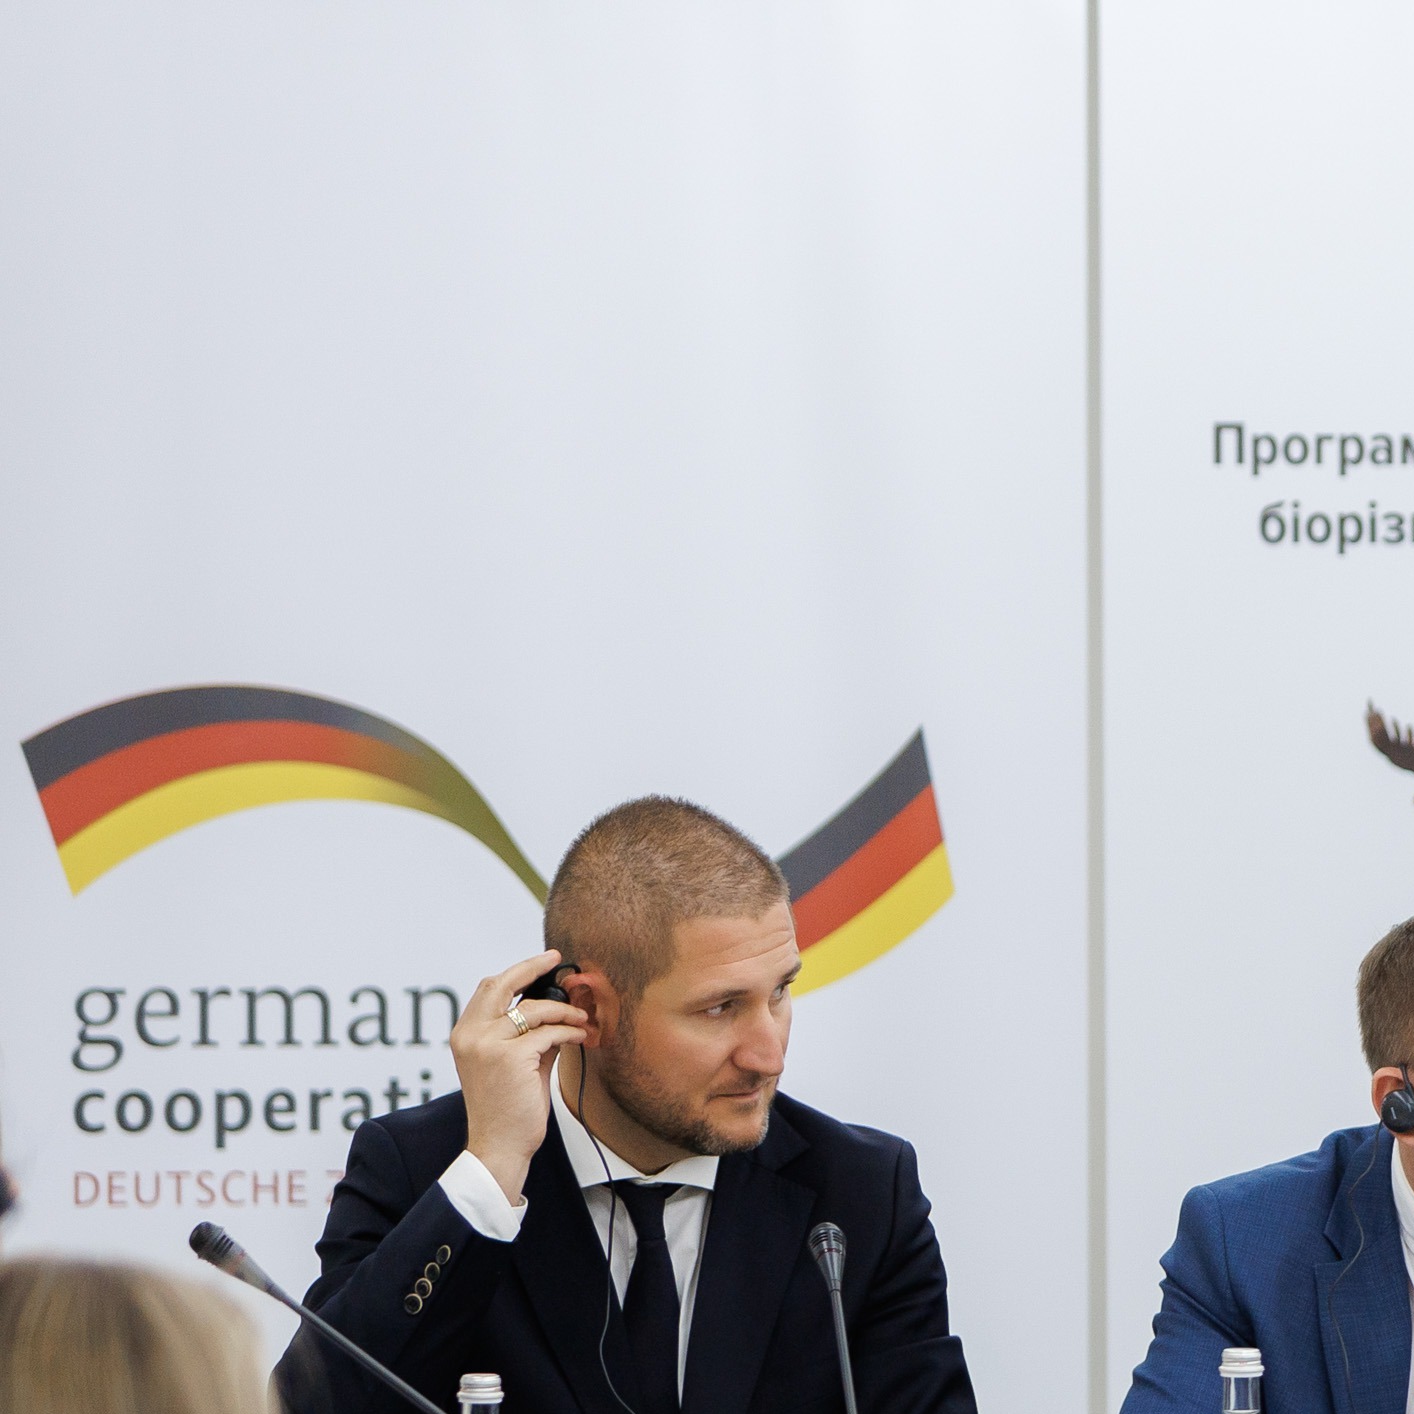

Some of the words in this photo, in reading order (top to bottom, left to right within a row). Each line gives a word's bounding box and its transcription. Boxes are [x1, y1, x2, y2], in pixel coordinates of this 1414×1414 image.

[71, 984, 461, 1072] german
[73, 1069, 437, 1150] cooperati
[74, 1169, 309, 1209] DEUTSCHE
